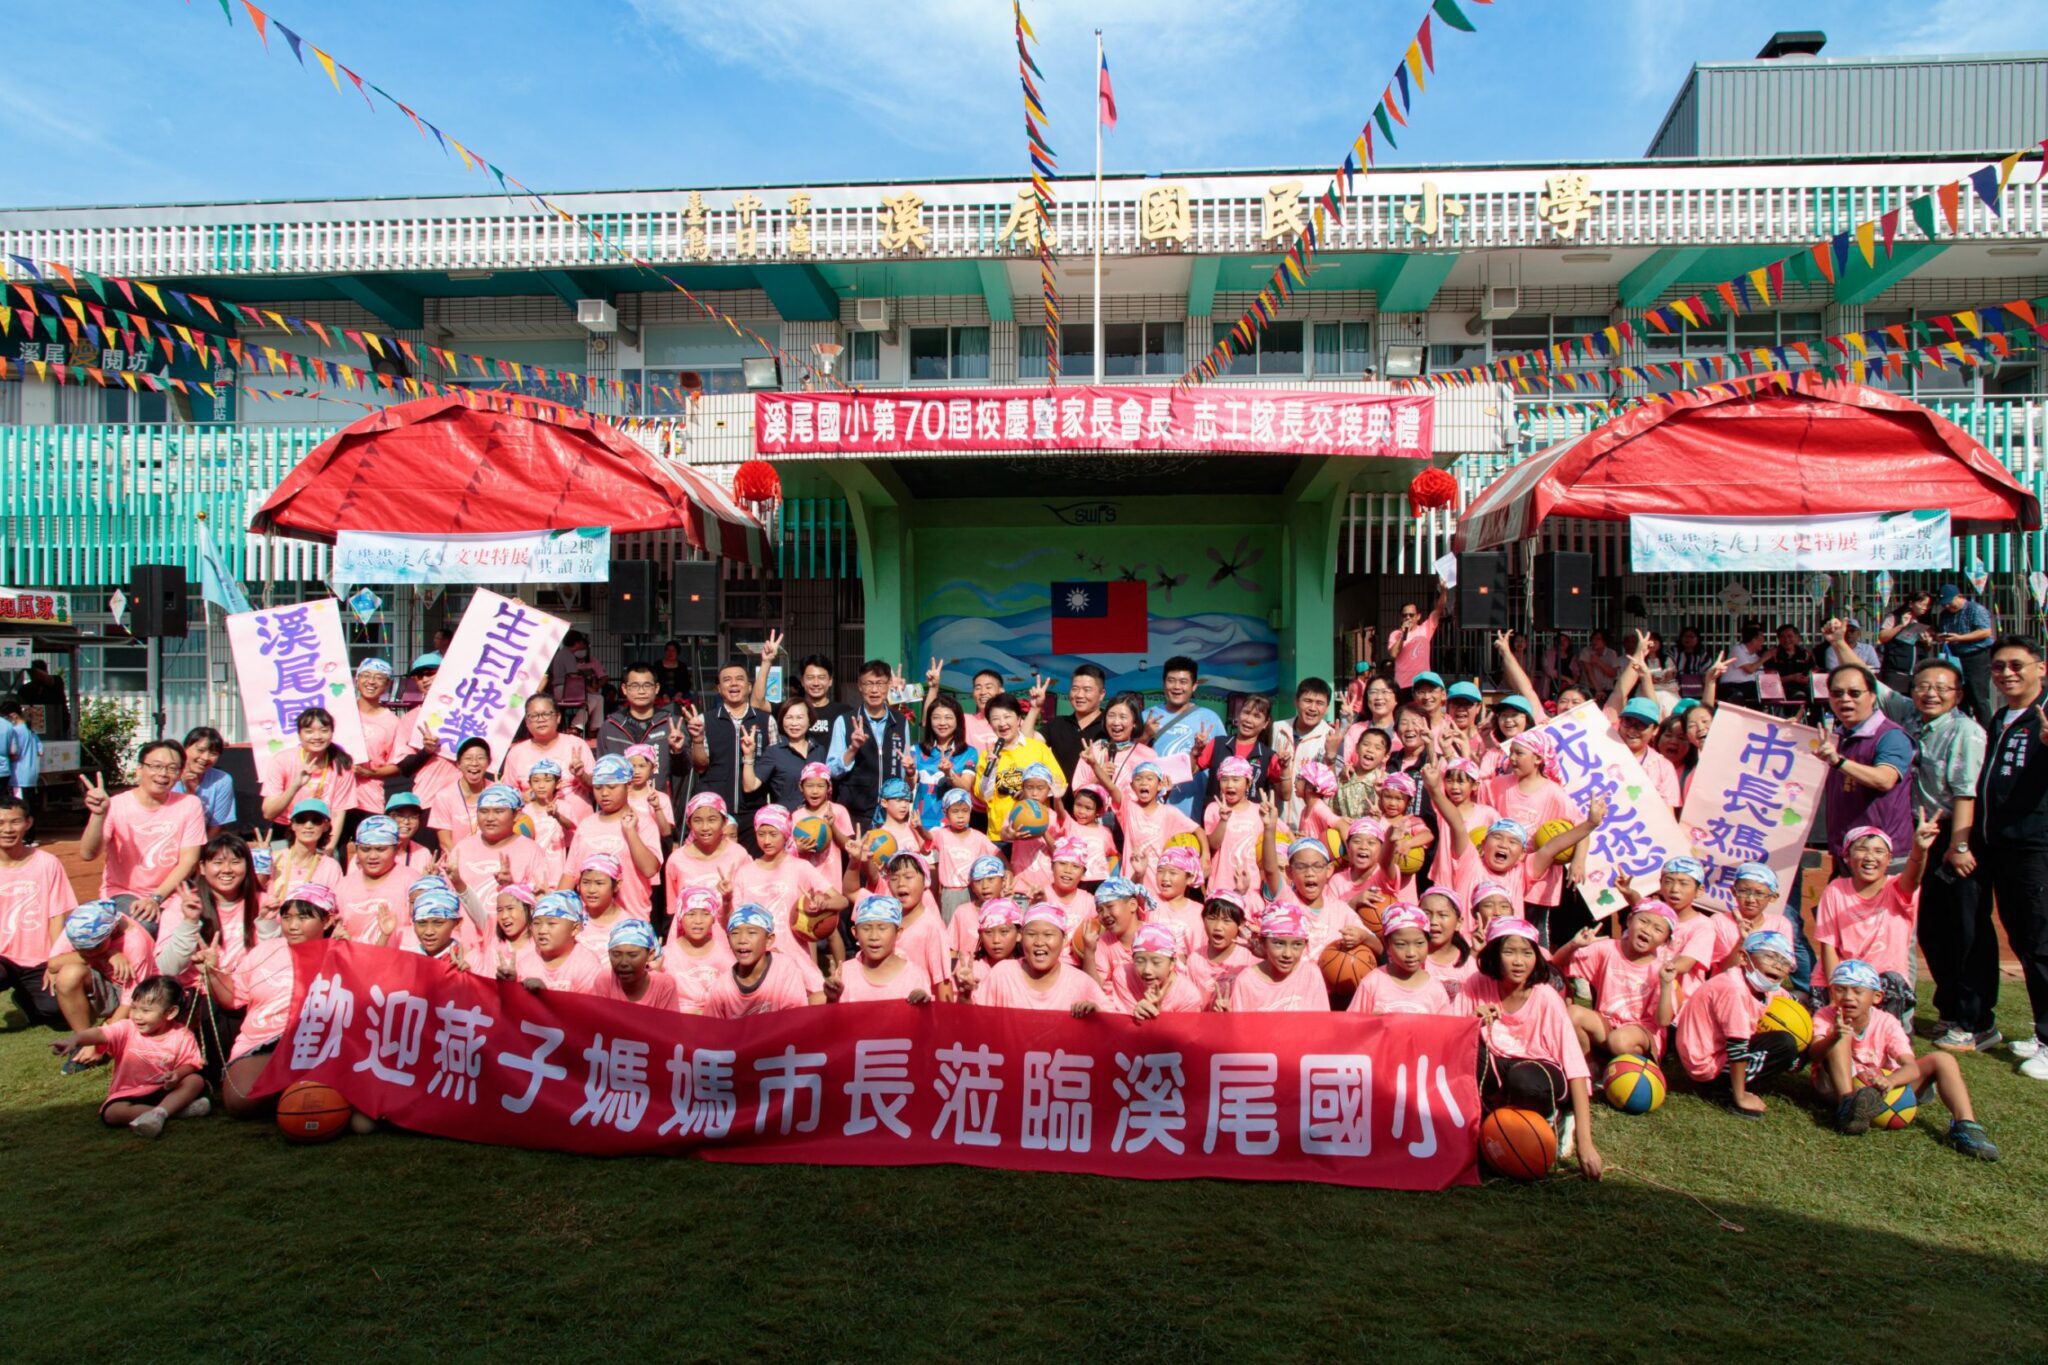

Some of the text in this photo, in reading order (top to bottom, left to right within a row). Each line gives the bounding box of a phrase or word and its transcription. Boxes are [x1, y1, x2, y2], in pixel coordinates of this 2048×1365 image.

[877, 173, 1602, 250] 溪尾國民小學
[438, 602, 540, 753] 生日快樂
[290, 973, 1465, 1158] 歡迎燕子媽媽市長蒞臨溪尾國小
